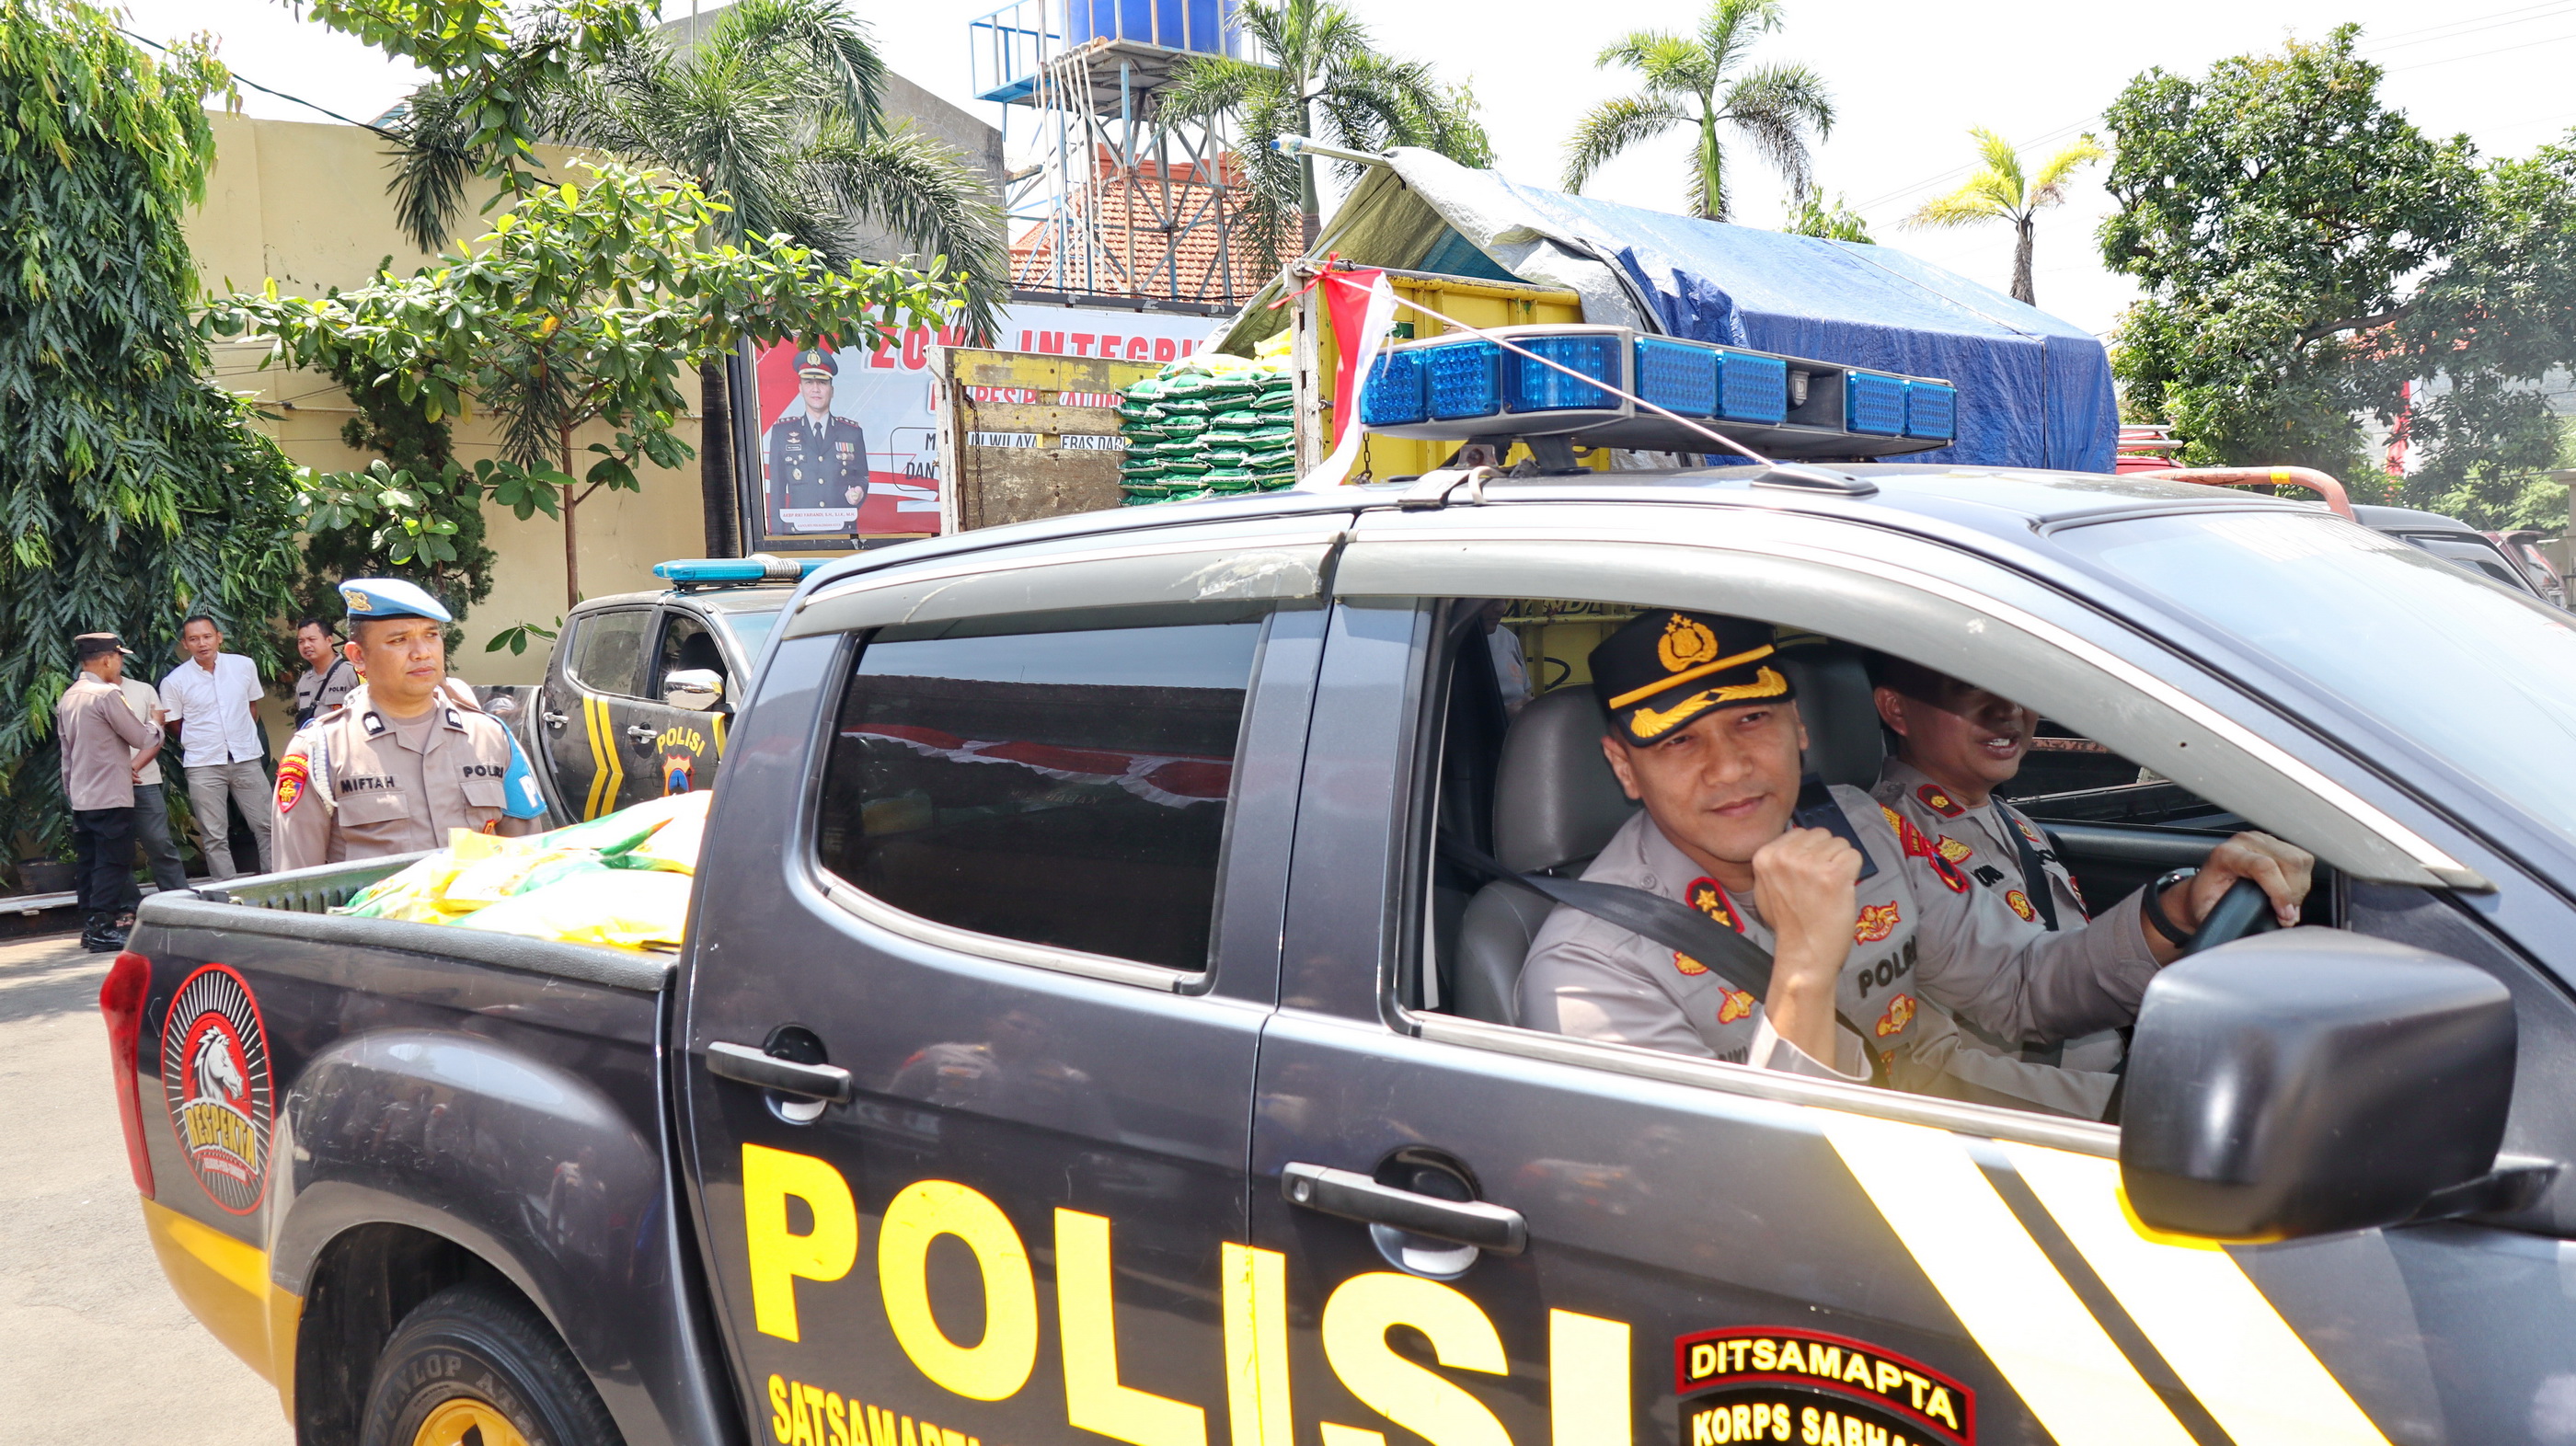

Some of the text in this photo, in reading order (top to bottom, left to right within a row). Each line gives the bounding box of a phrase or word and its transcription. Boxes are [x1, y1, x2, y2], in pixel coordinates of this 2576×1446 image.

[906, 462, 935, 479] DAN
[656, 726, 706, 758] POLISI
[339, 775, 396, 794] MIFTAH
[184, 1102, 257, 1172] RESPEKTA
[742, 1143, 1631, 1446] POLISI
[768, 1373, 982, 1446] SATSAM
[1691, 1338, 1959, 1430] DITSAMAPTA
[1693, 1404, 1791, 1446] KORPS
